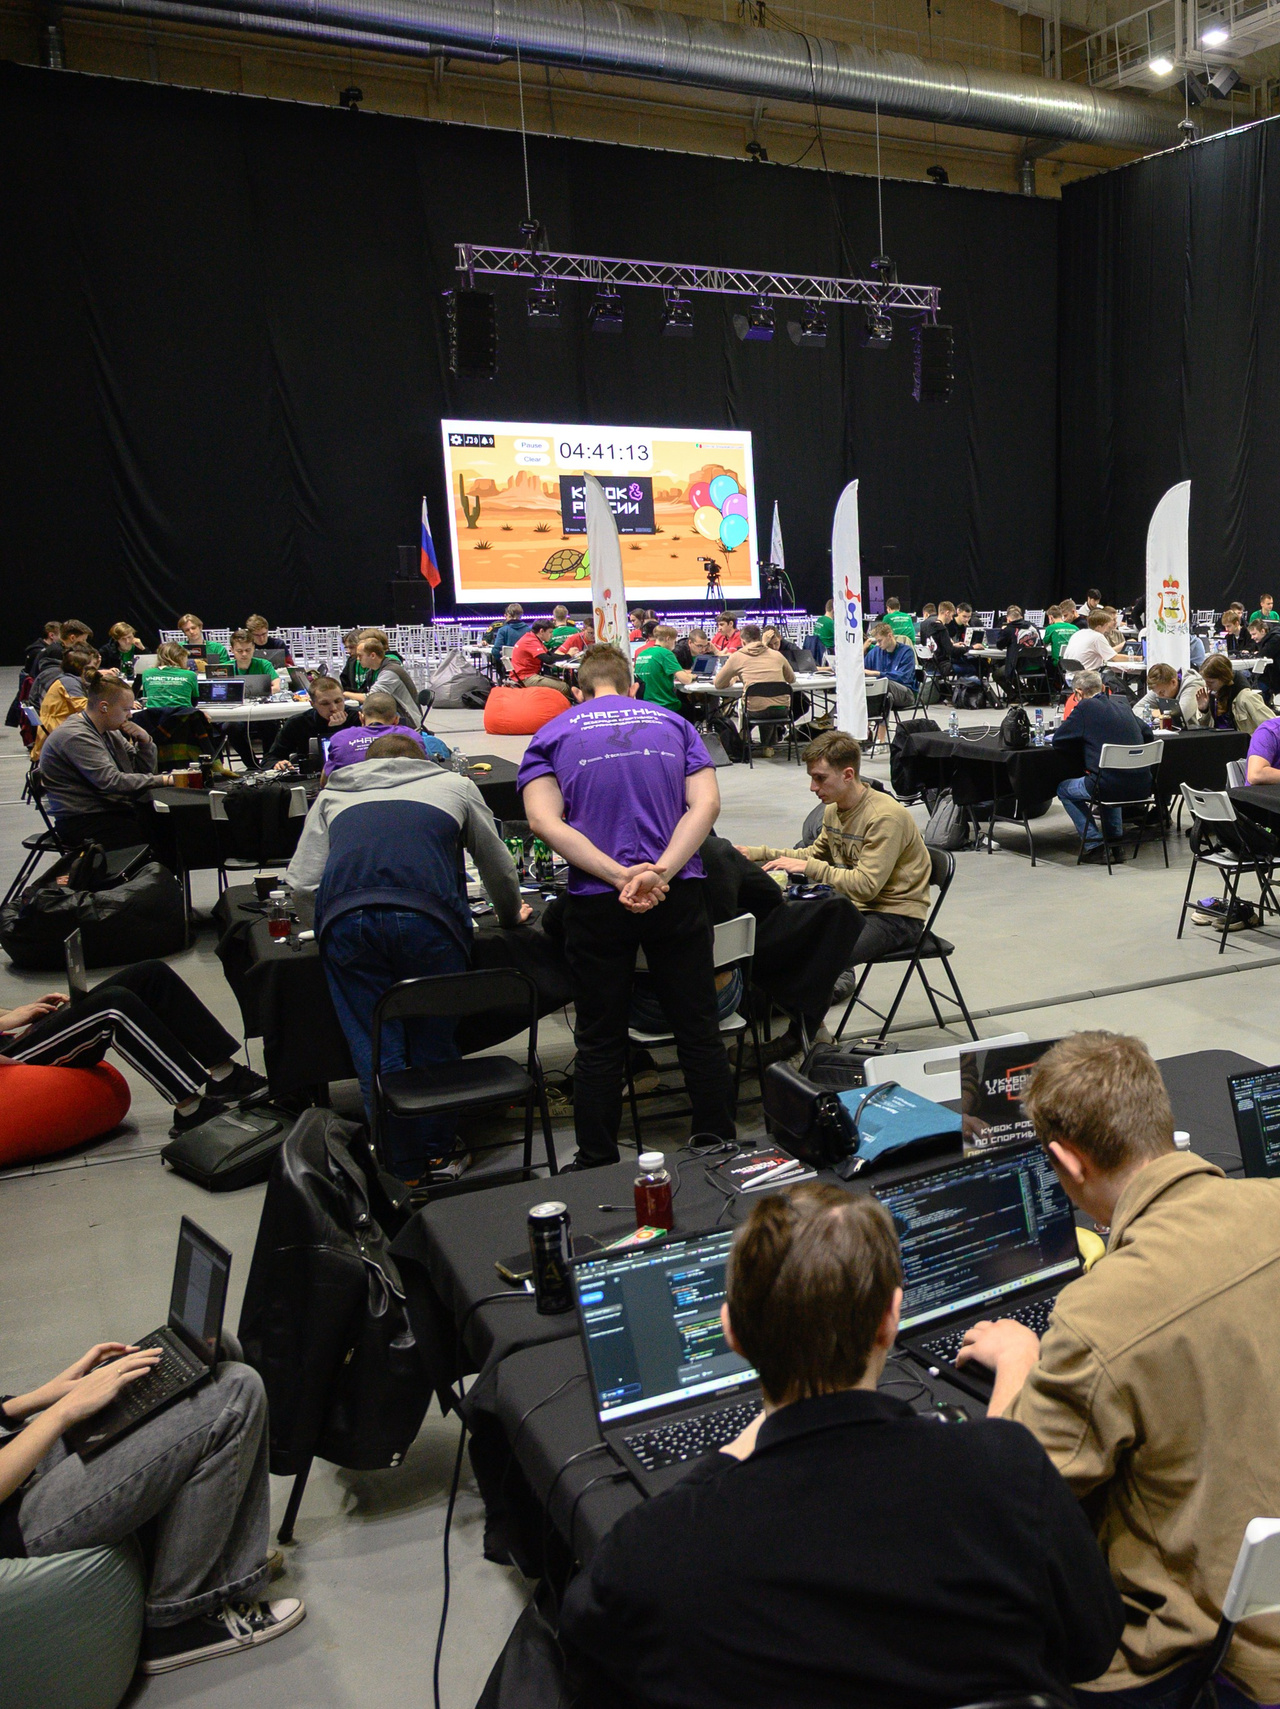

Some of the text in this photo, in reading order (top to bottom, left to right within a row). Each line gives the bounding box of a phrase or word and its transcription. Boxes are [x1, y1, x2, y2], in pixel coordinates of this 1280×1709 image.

[560, 442, 650, 461] 04:41:13
[571, 486, 628, 500] КОК
[572, 501, 640, 514] РСИИ
[980, 1120, 1034, 1135] КУБОК РОС
[975, 1138, 988, 1146] ПО
